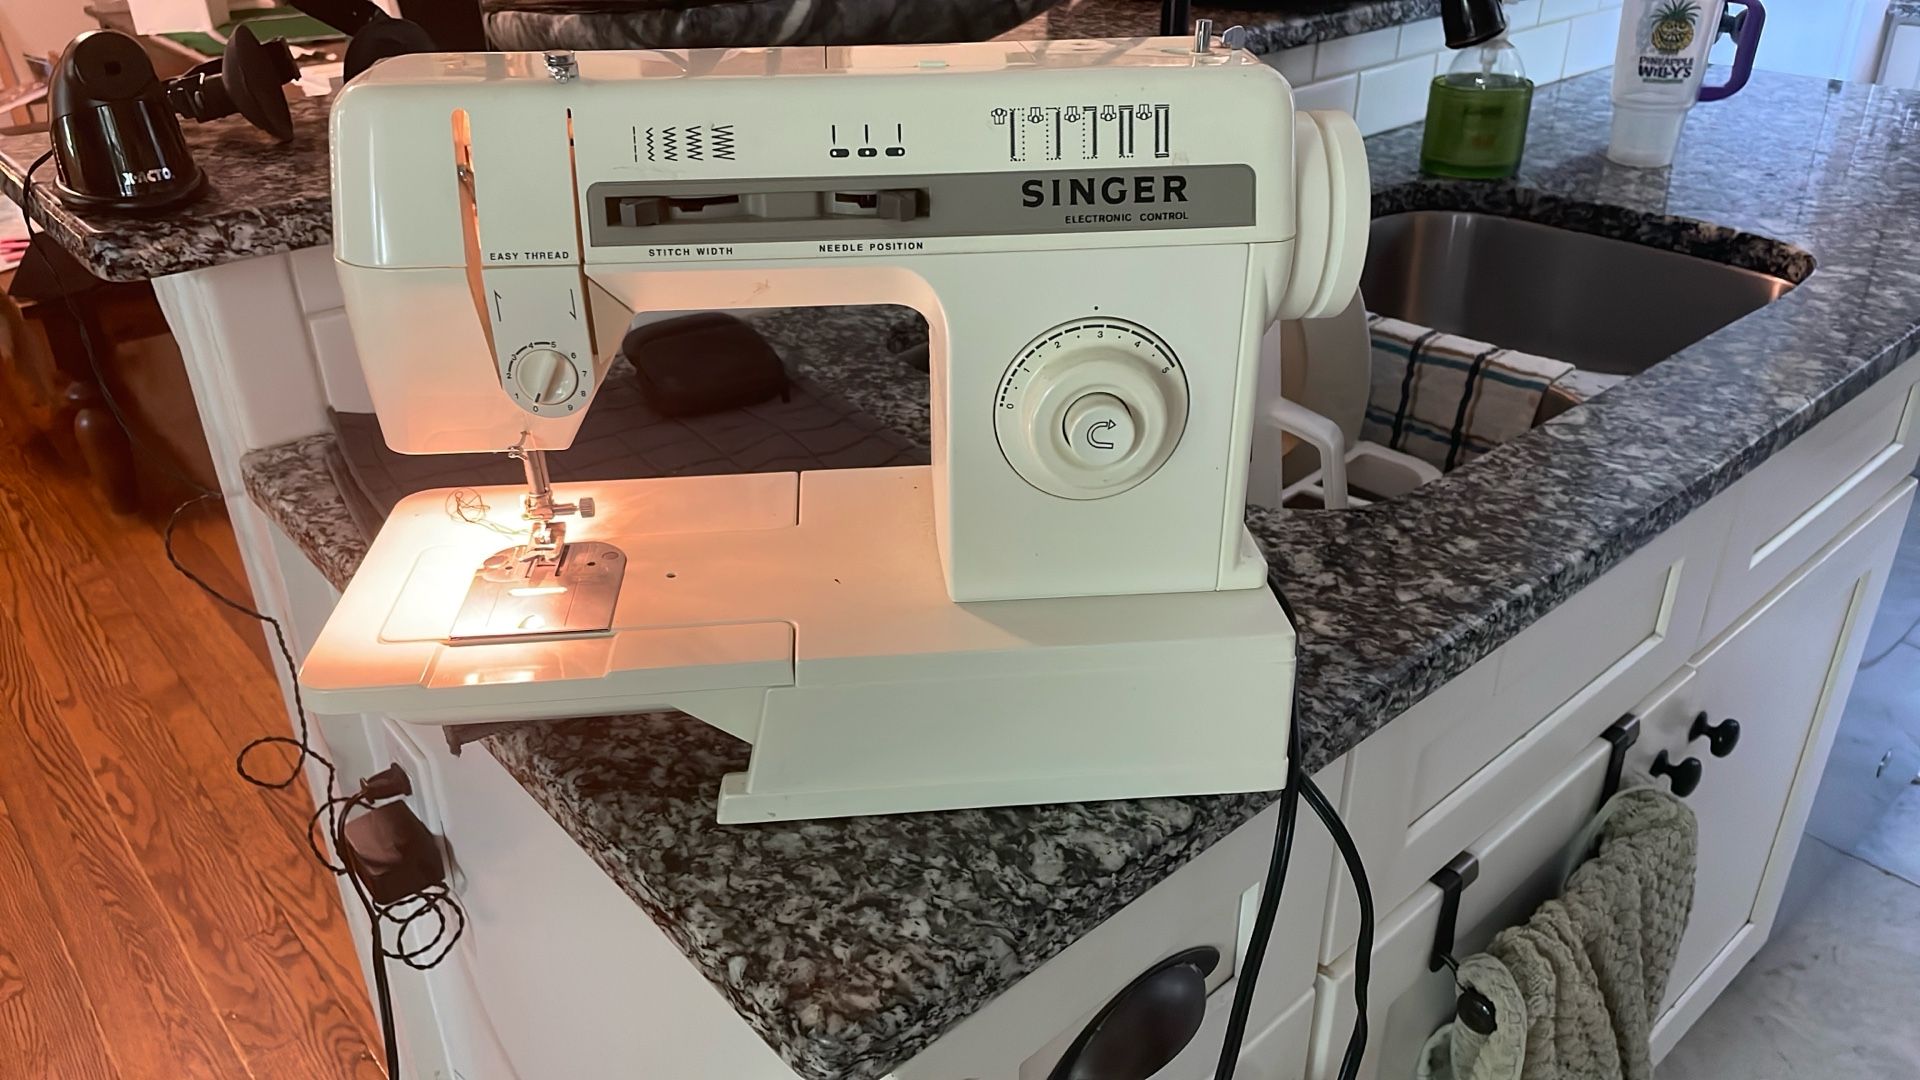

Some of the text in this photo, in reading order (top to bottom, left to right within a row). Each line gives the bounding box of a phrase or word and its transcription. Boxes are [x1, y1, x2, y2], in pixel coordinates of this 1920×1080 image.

[1021, 175, 1188, 208] SINGER
[1065, 212, 1188, 224] ELECTRONIC CONTROL
[648, 247, 733, 257] STITCH WIDTH
[819, 242, 923, 252] NEEDLE POSITION
[489, 251, 569, 261] EASY THREAD
[511, 353, 517, 361] 3
[1054, 341, 1062, 349] 2
[1097, 331, 1104, 339] 3
[1134, 340, 1141, 348] 4
[1161, 366, 1169, 374] 5
[532, 405, 539, 413] 0
